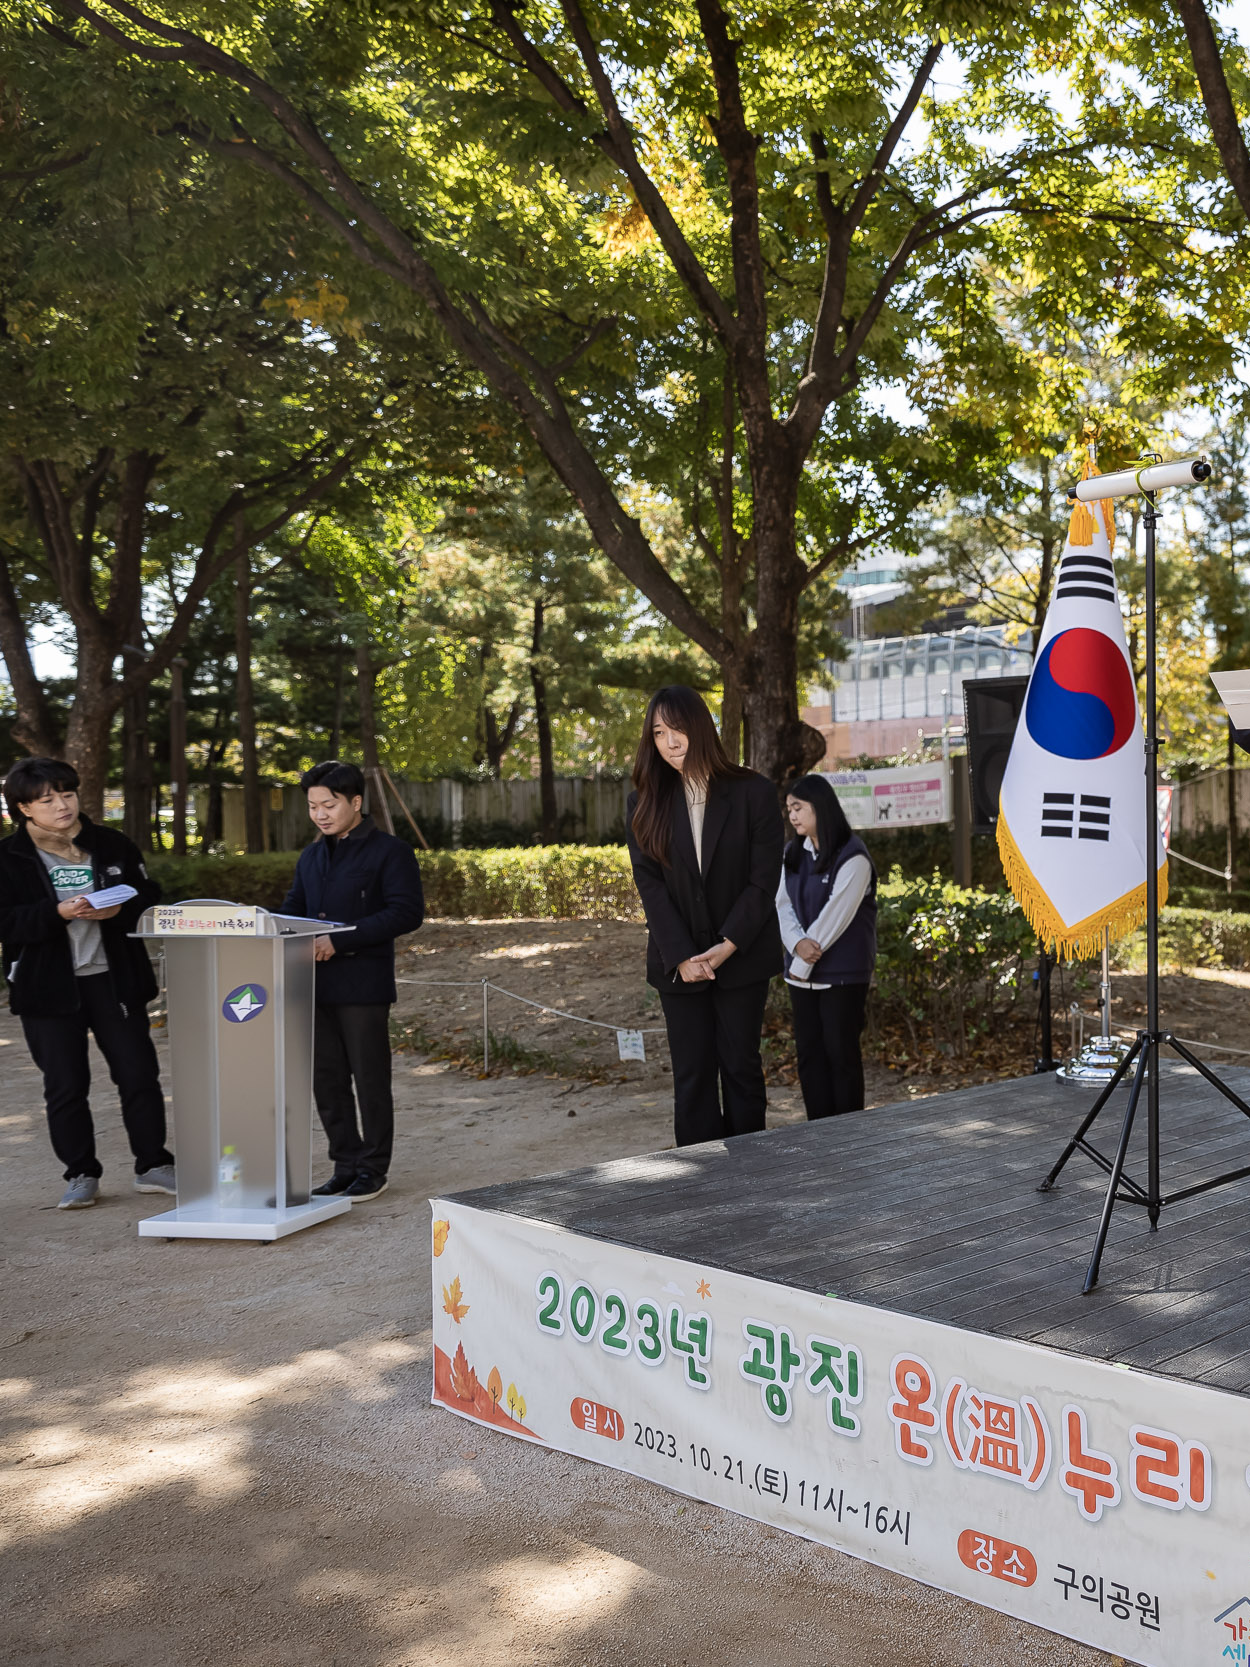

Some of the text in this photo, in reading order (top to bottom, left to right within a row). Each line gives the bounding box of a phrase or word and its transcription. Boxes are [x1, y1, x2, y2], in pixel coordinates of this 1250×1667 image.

[53, 869, 78, 880] LAND
[538, 1275, 709, 1385] 2023년
[742, 1325, 859, 1431] 광진
[581, 1402, 619, 1440] 일시
[972, 1537, 1161, 1632] 장소 구의공원
